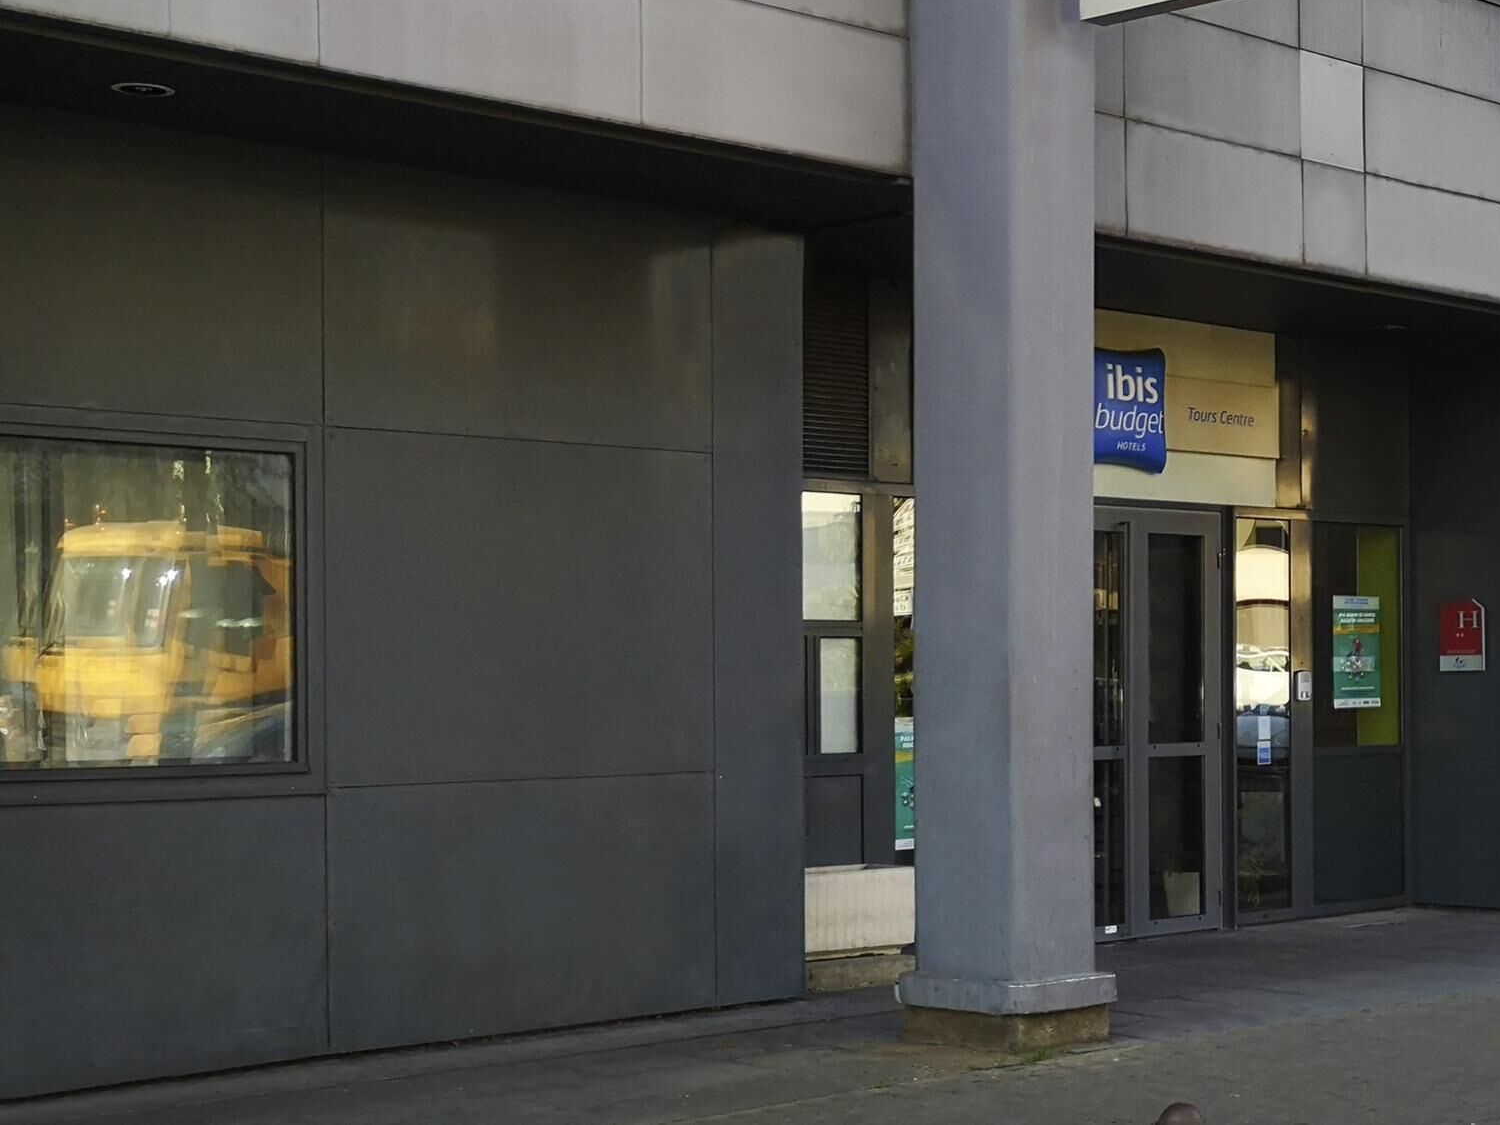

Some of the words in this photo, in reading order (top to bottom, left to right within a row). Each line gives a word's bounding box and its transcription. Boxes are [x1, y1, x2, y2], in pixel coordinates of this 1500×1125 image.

[1105, 363, 1159, 404] ibis
[1095, 403, 1165, 439] budget
[1187, 407, 1217, 422] Tours
[1219, 410, 1255, 427] Centre
[1117, 441, 1146, 452] HOTELS
[1456, 610, 1479, 629] H
